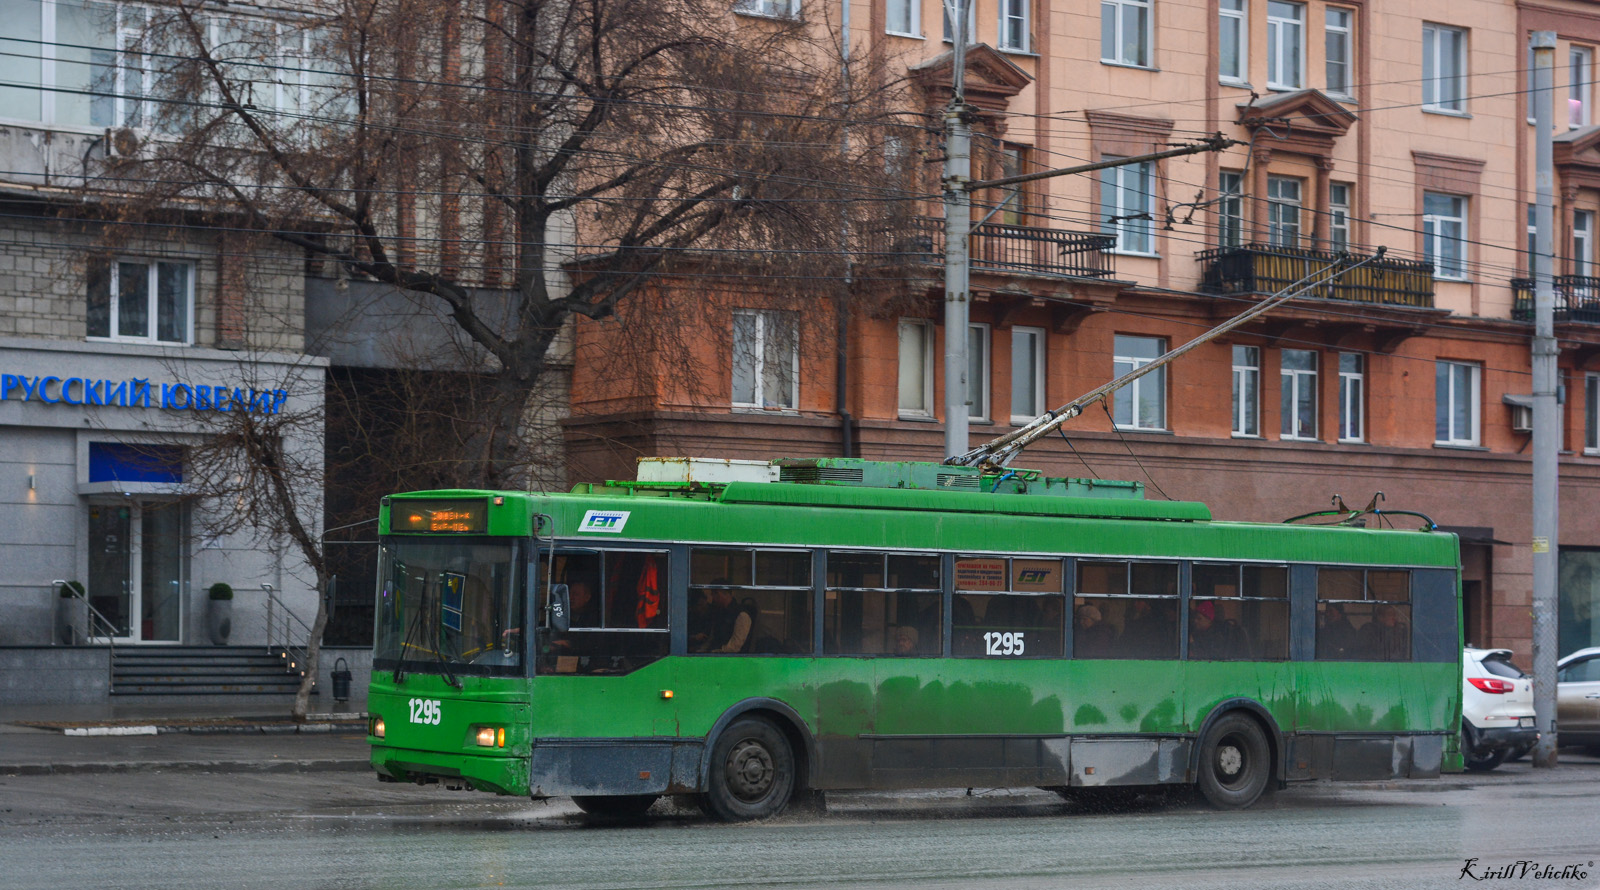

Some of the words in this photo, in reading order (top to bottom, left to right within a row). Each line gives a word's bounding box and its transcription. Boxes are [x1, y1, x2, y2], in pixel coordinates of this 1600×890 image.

[1, 374, 151, 407] РУССКИЙ
[161, 383, 287, 414] ЮВЕЛИР
[984, 632, 1024, 655] 1295
[408, 698, 441, 725] 1295
